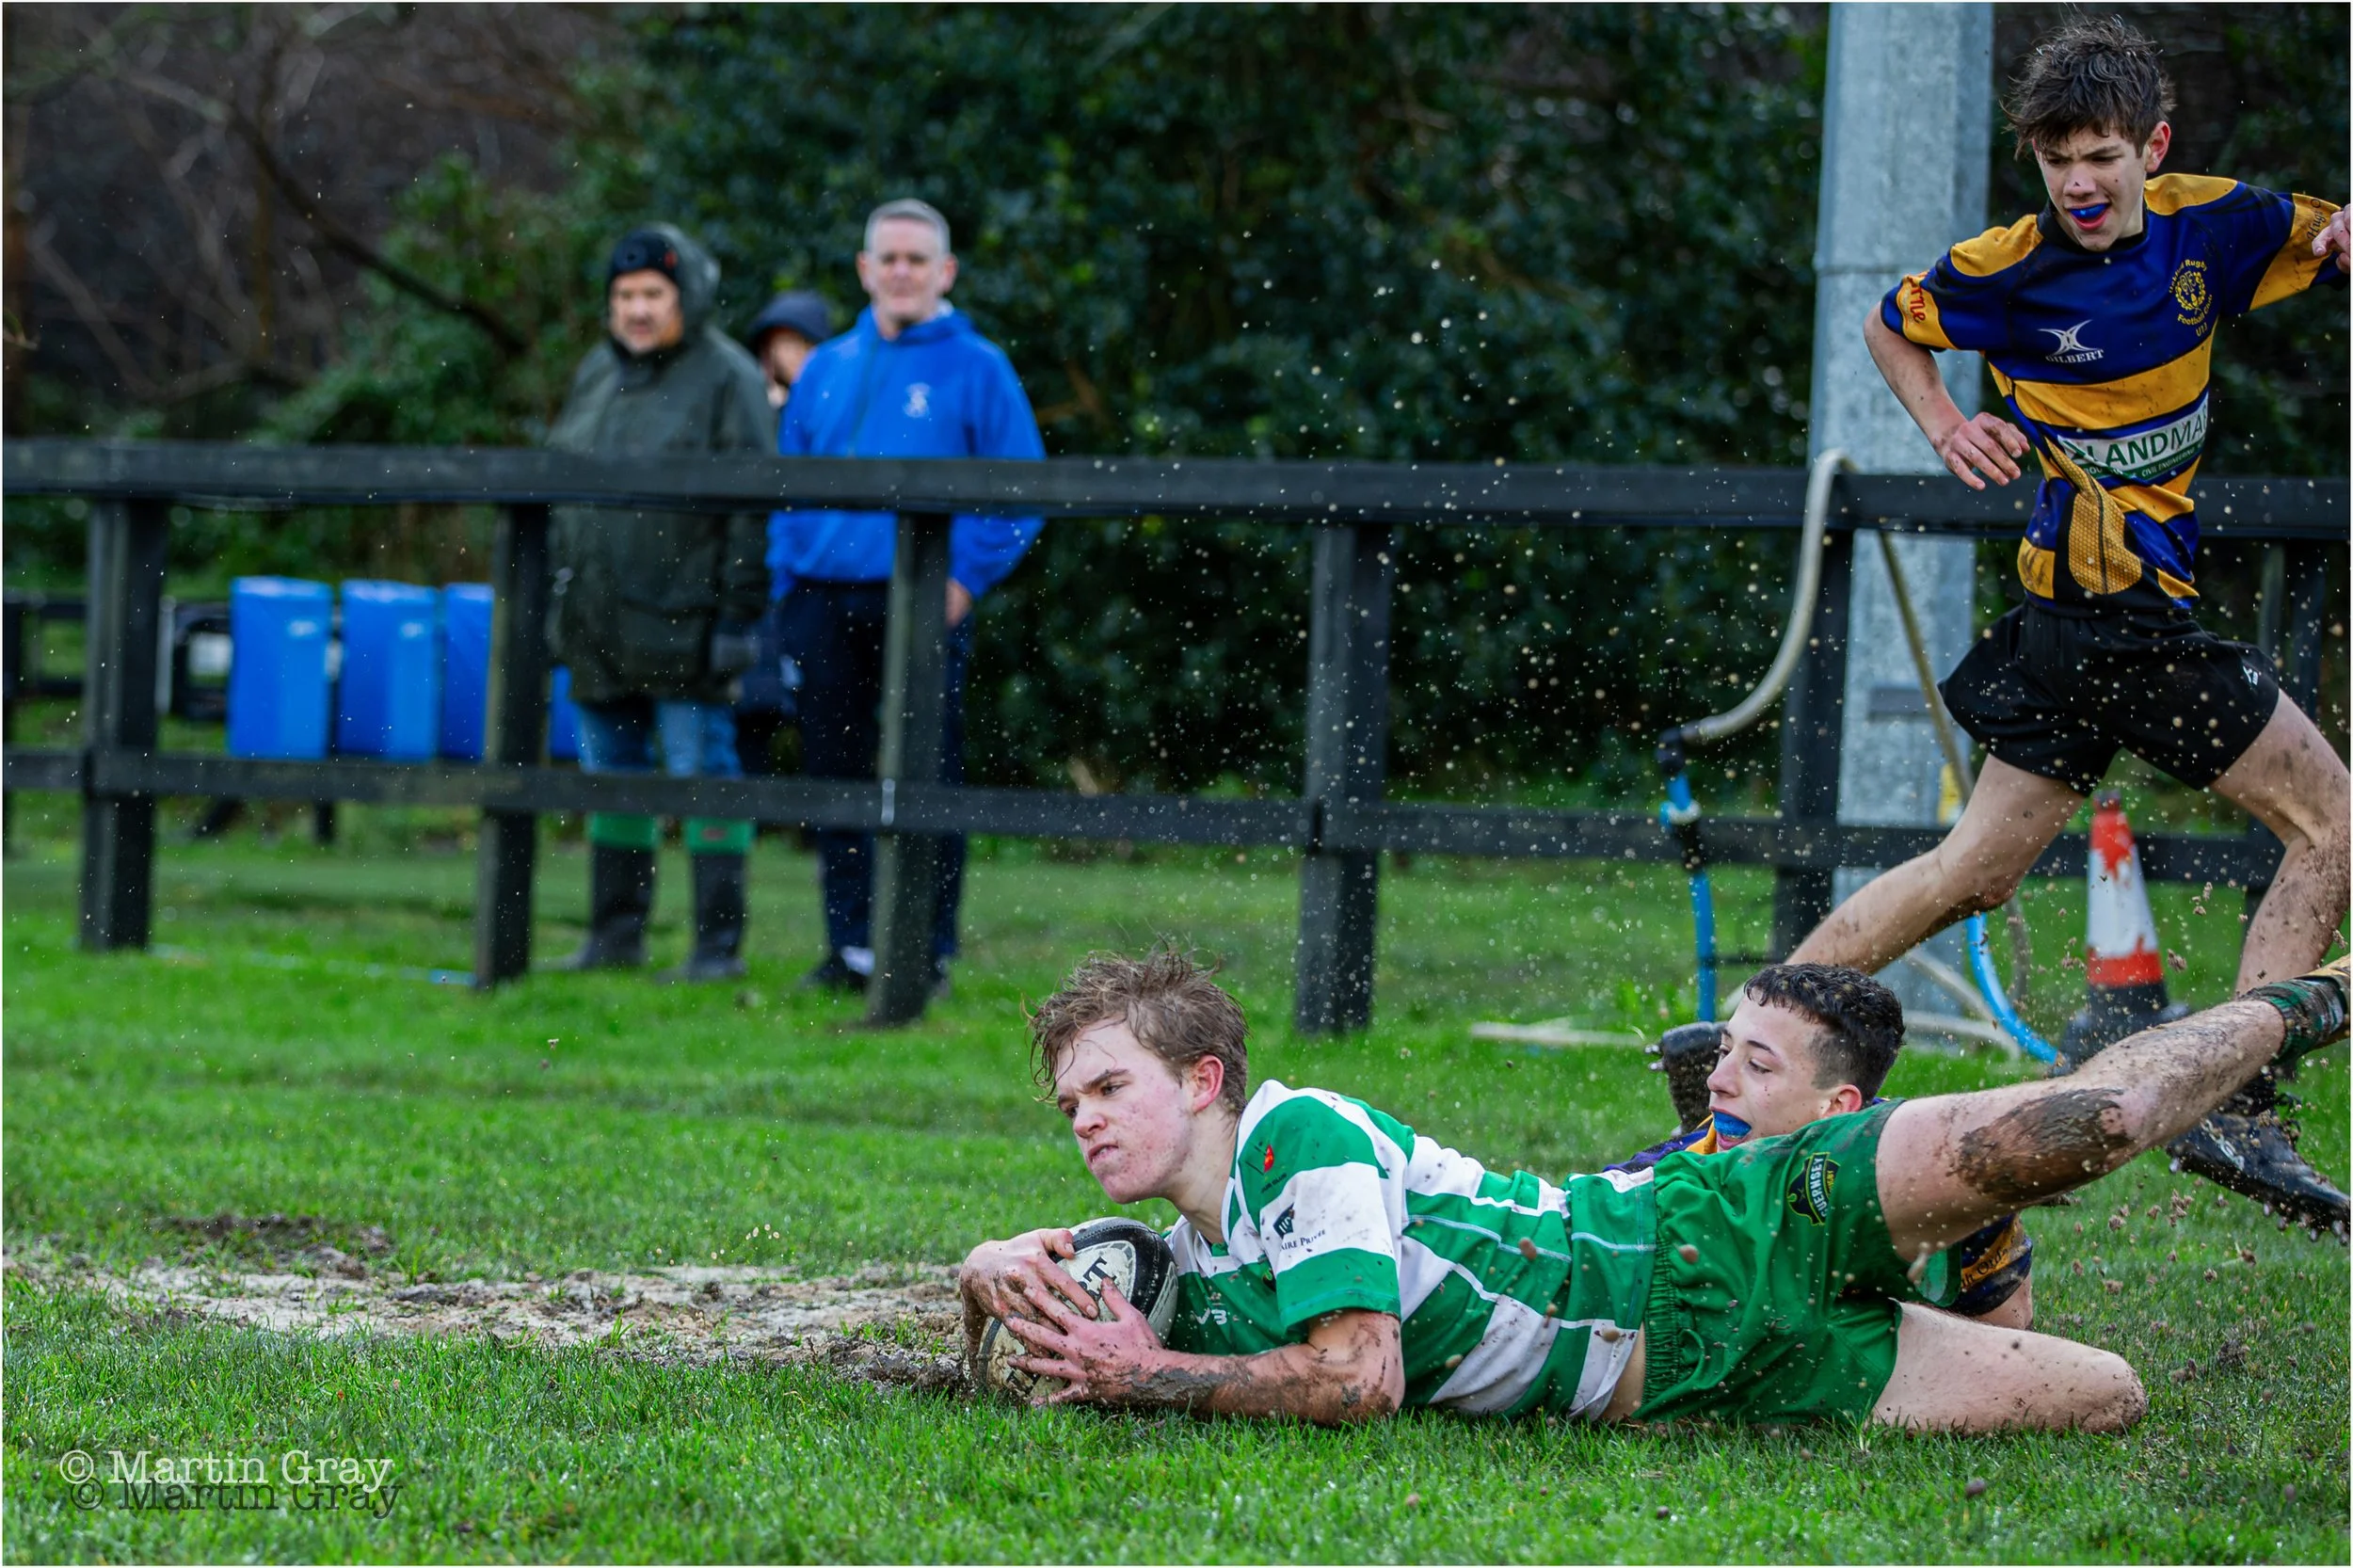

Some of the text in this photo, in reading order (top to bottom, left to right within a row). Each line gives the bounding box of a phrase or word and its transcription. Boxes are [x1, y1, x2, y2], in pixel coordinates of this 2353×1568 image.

[2185, 259, 2207, 272] Rugby
[2044, 349, 2105, 364] GILBERT
[1809, 1157, 1829, 1218] GUERNSEY
